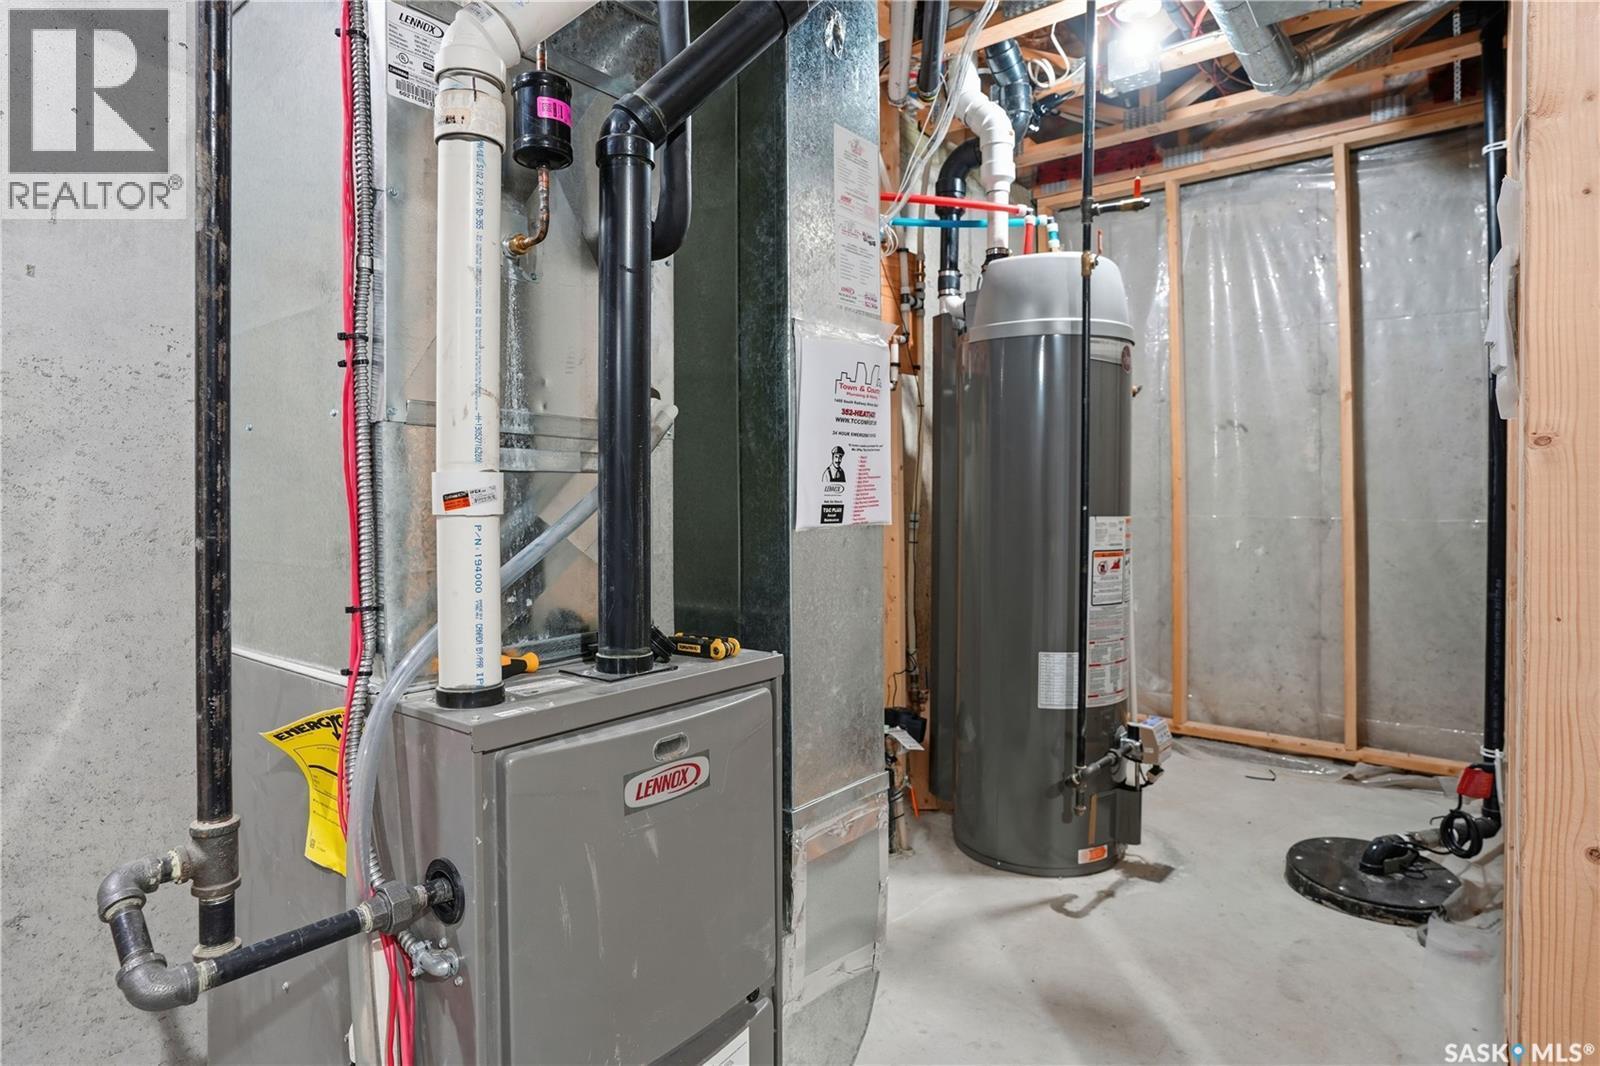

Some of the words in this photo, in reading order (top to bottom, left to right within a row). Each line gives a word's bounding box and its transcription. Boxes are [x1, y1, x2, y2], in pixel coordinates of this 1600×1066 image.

[399, 13, 435, 34] LENNOX
[839, 382, 858, 391] Town
[474, 553, 483, 594] 194000
[475, 623, 484, 645] CANADA
[635, 767, 689, 801] LENNOX
